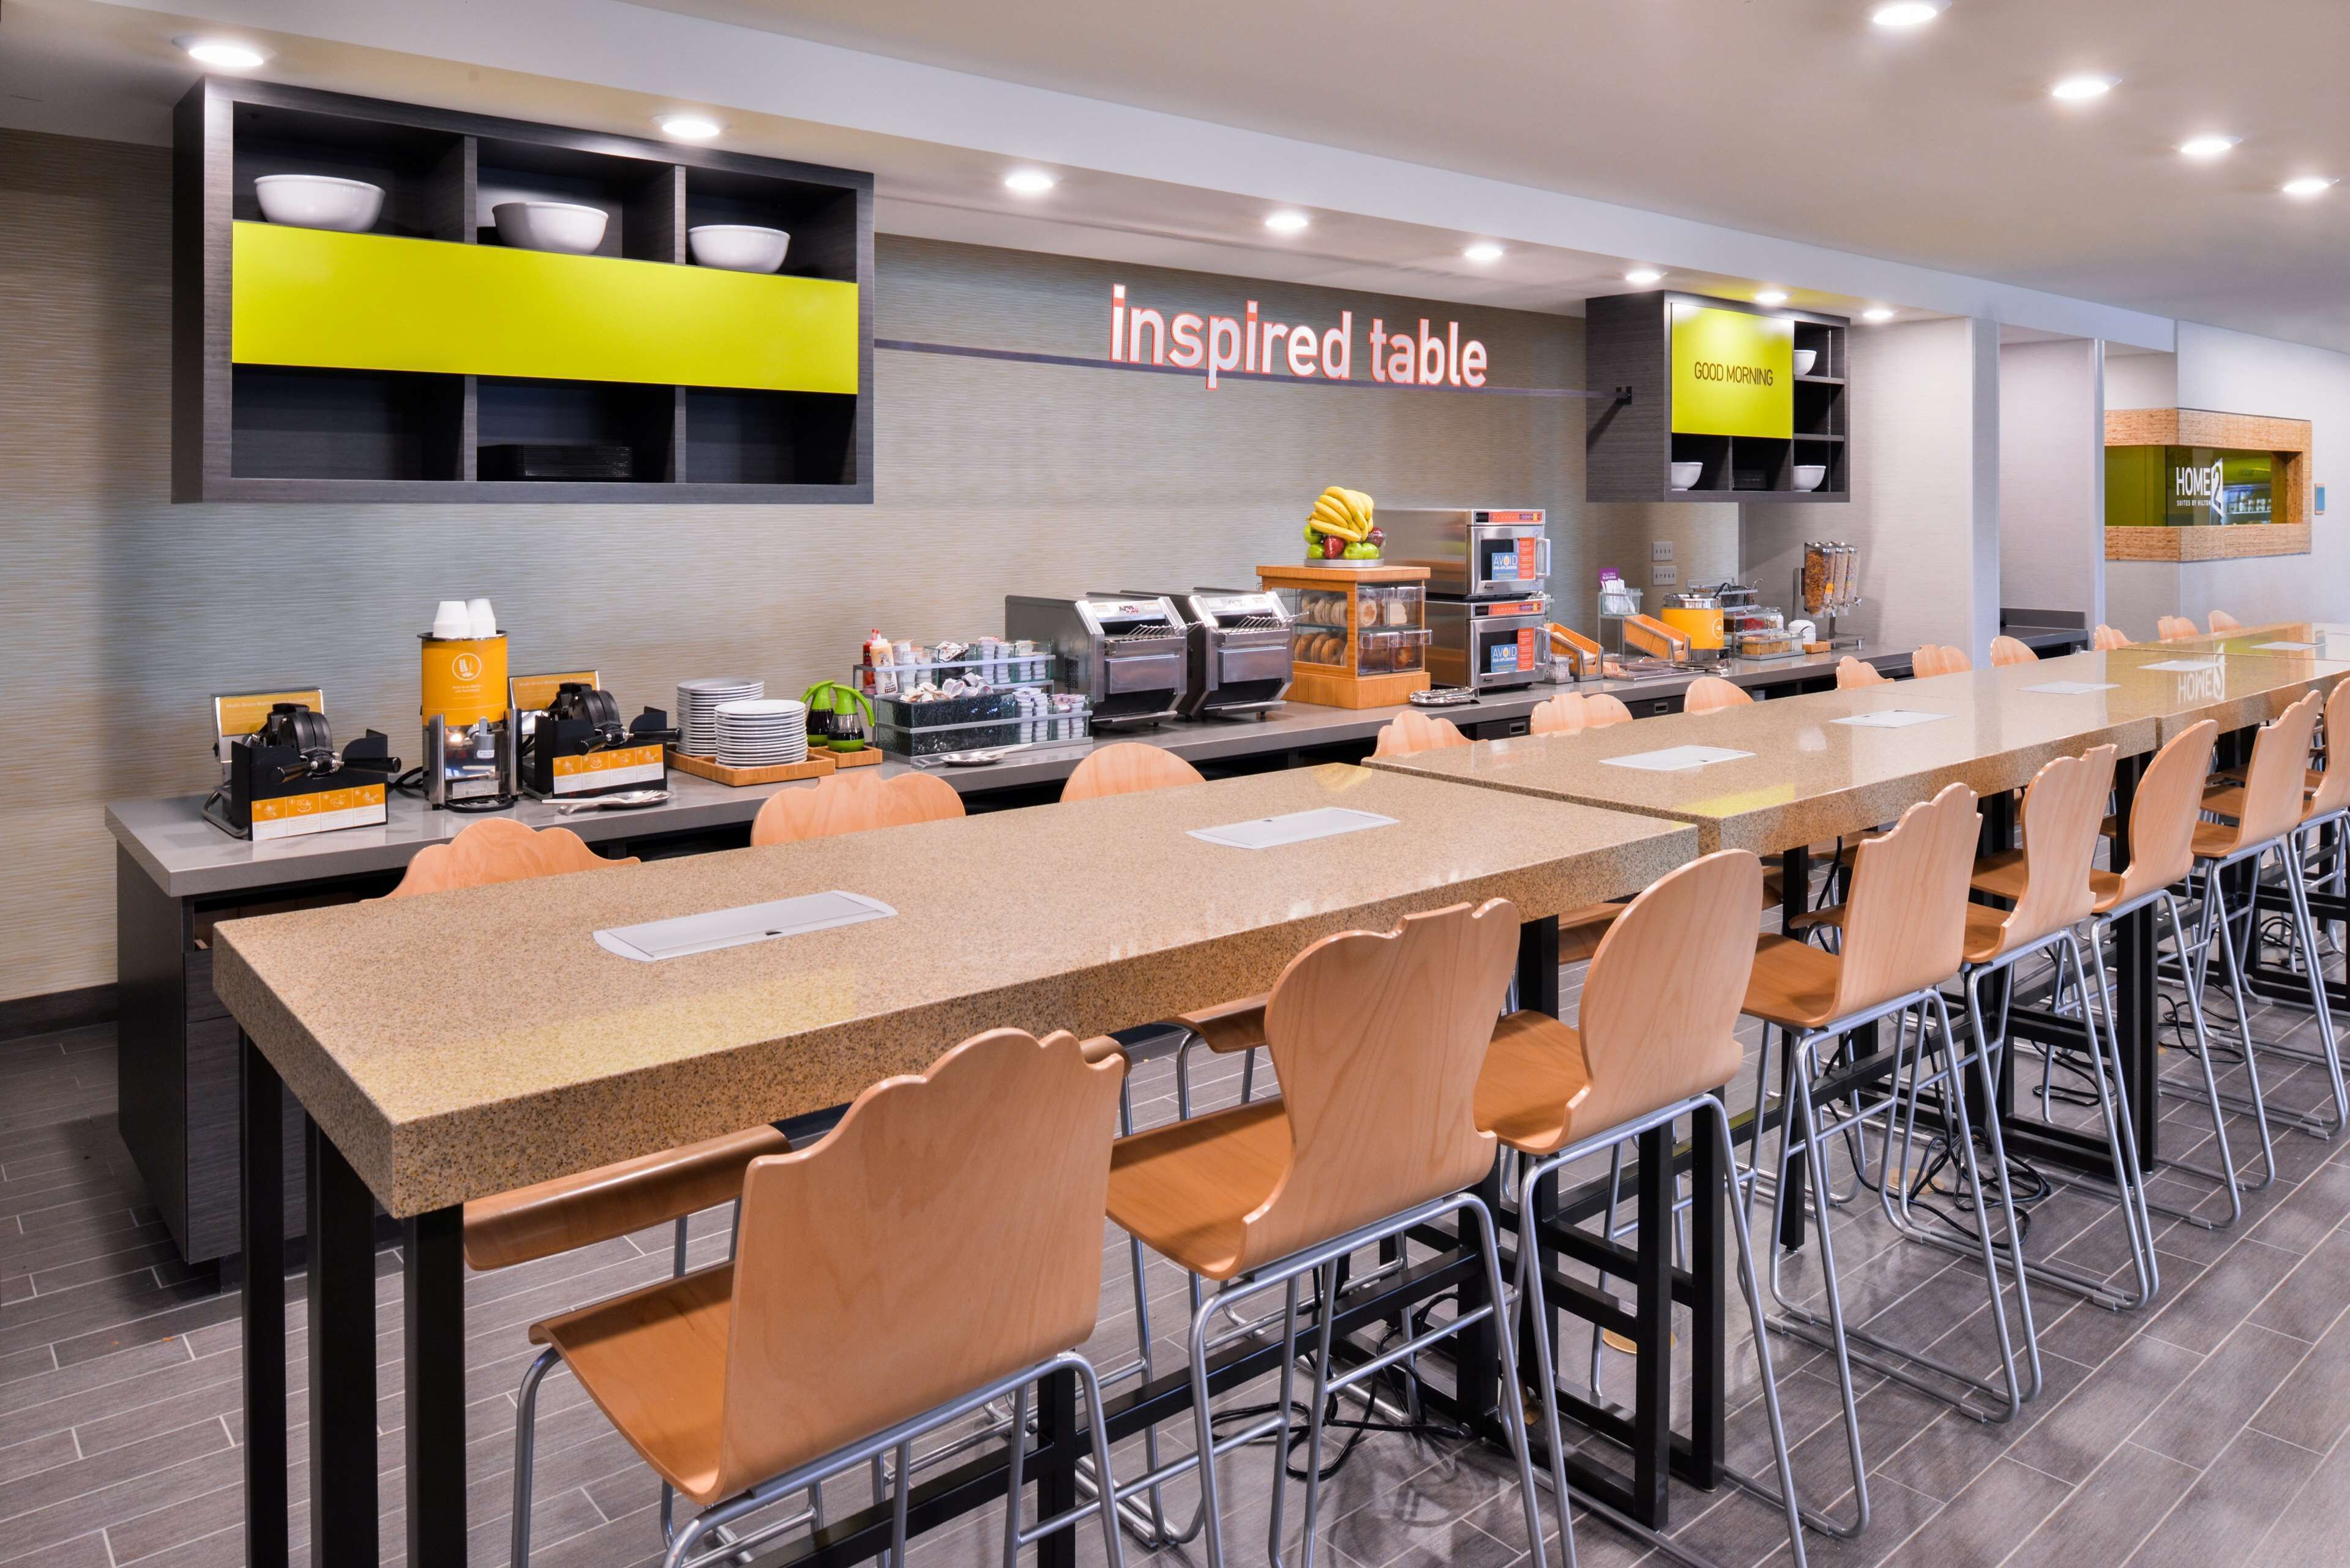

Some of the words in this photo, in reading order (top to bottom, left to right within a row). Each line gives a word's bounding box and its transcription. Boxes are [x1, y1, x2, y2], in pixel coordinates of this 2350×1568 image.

[1110, 283, 1352, 390] inspired
[1369, 319, 1487, 387] table
[1694, 362, 1723, 381] GOOD
[1726, 365, 1773, 386] MORNING
[2176, 467, 2211, 496] HOME
[1493, 555, 1518, 566] AVOID
[1492, 646, 1517, 658] AVOID
